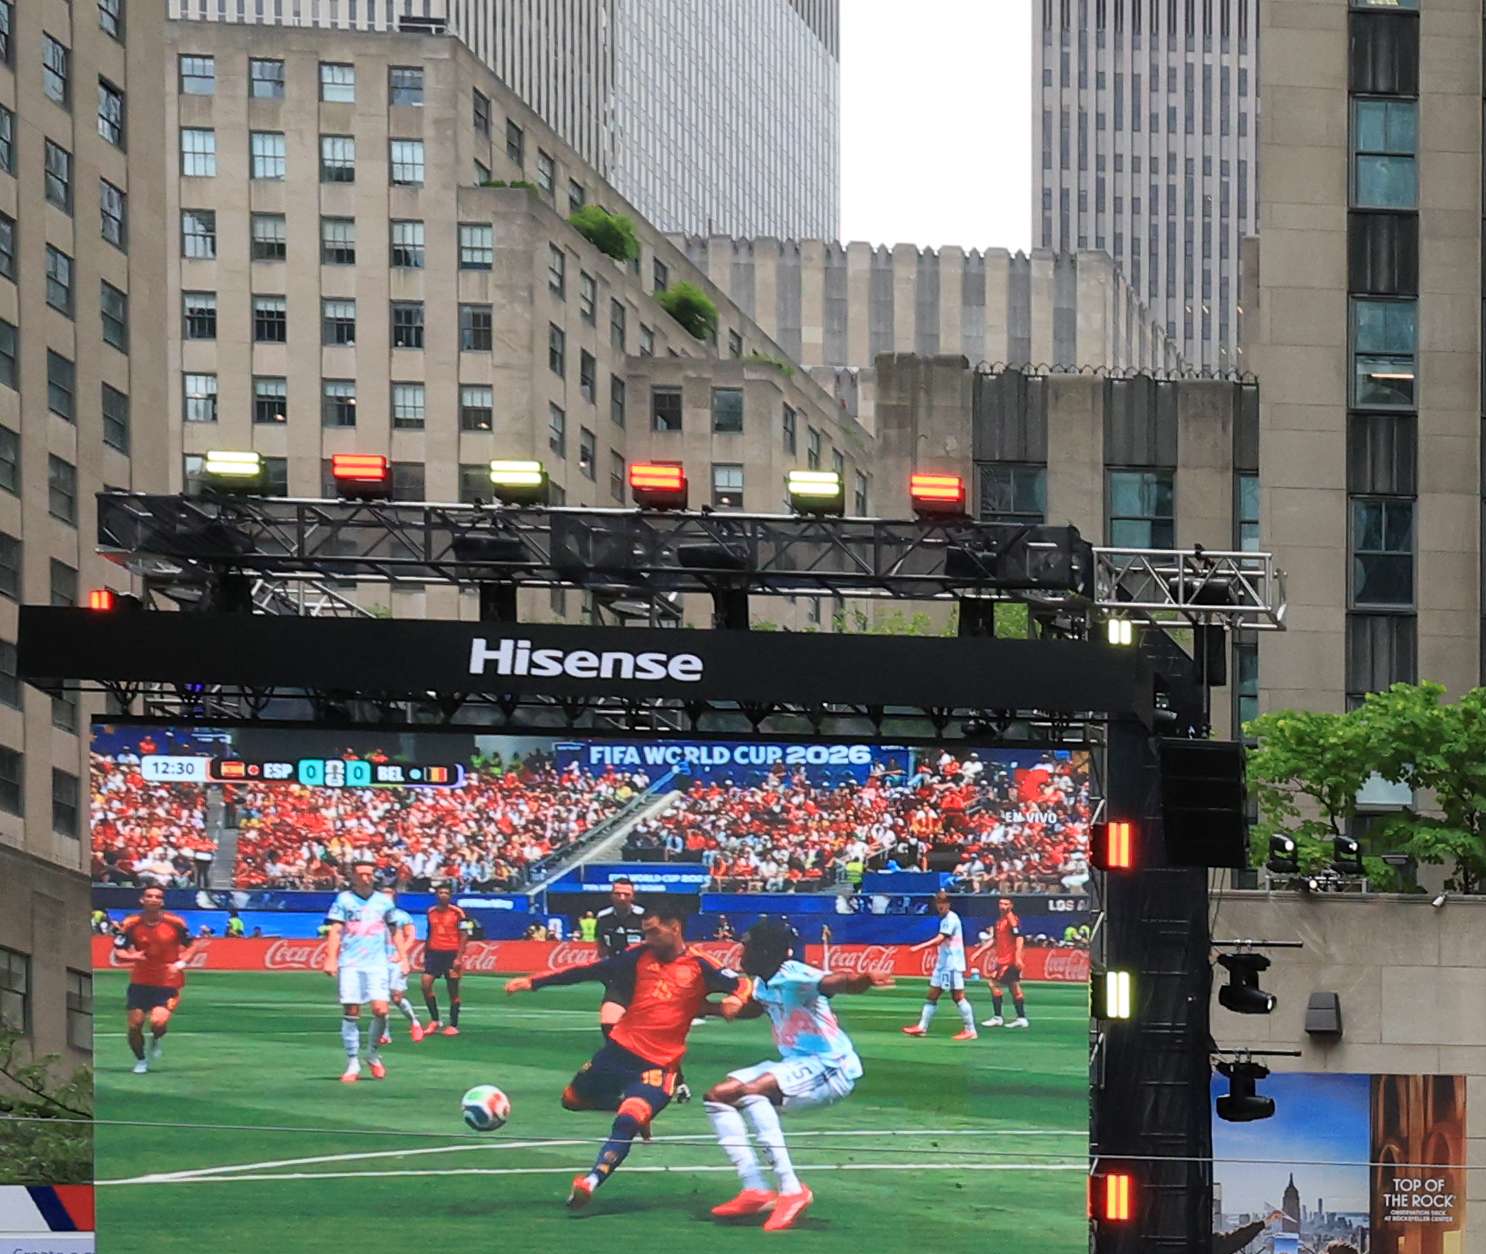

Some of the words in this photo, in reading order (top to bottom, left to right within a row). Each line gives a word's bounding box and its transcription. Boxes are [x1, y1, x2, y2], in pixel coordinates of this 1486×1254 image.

[469, 638, 703, 682] Hisense
[590, 745, 639, 765] FIFA
[645, 746, 730, 765] WORLD
[734, 746, 781, 764] CUP
[786, 745, 871, 765] 2026
[152, 761, 195, 776] 12:30
[264, 763, 292, 779] ESP
[307, 765, 317, 780] 0
[353, 766, 364, 781] 0
[377, 766, 405, 781] BEL
[1028, 812, 1057, 824] VIVO
[1392, 1178, 1421, 1192] TOP
[1424, 1178, 1445, 1192] OF
[1383, 1194, 1408, 1208] THE
[1411, 1194, 1453, 1208] ROCK
